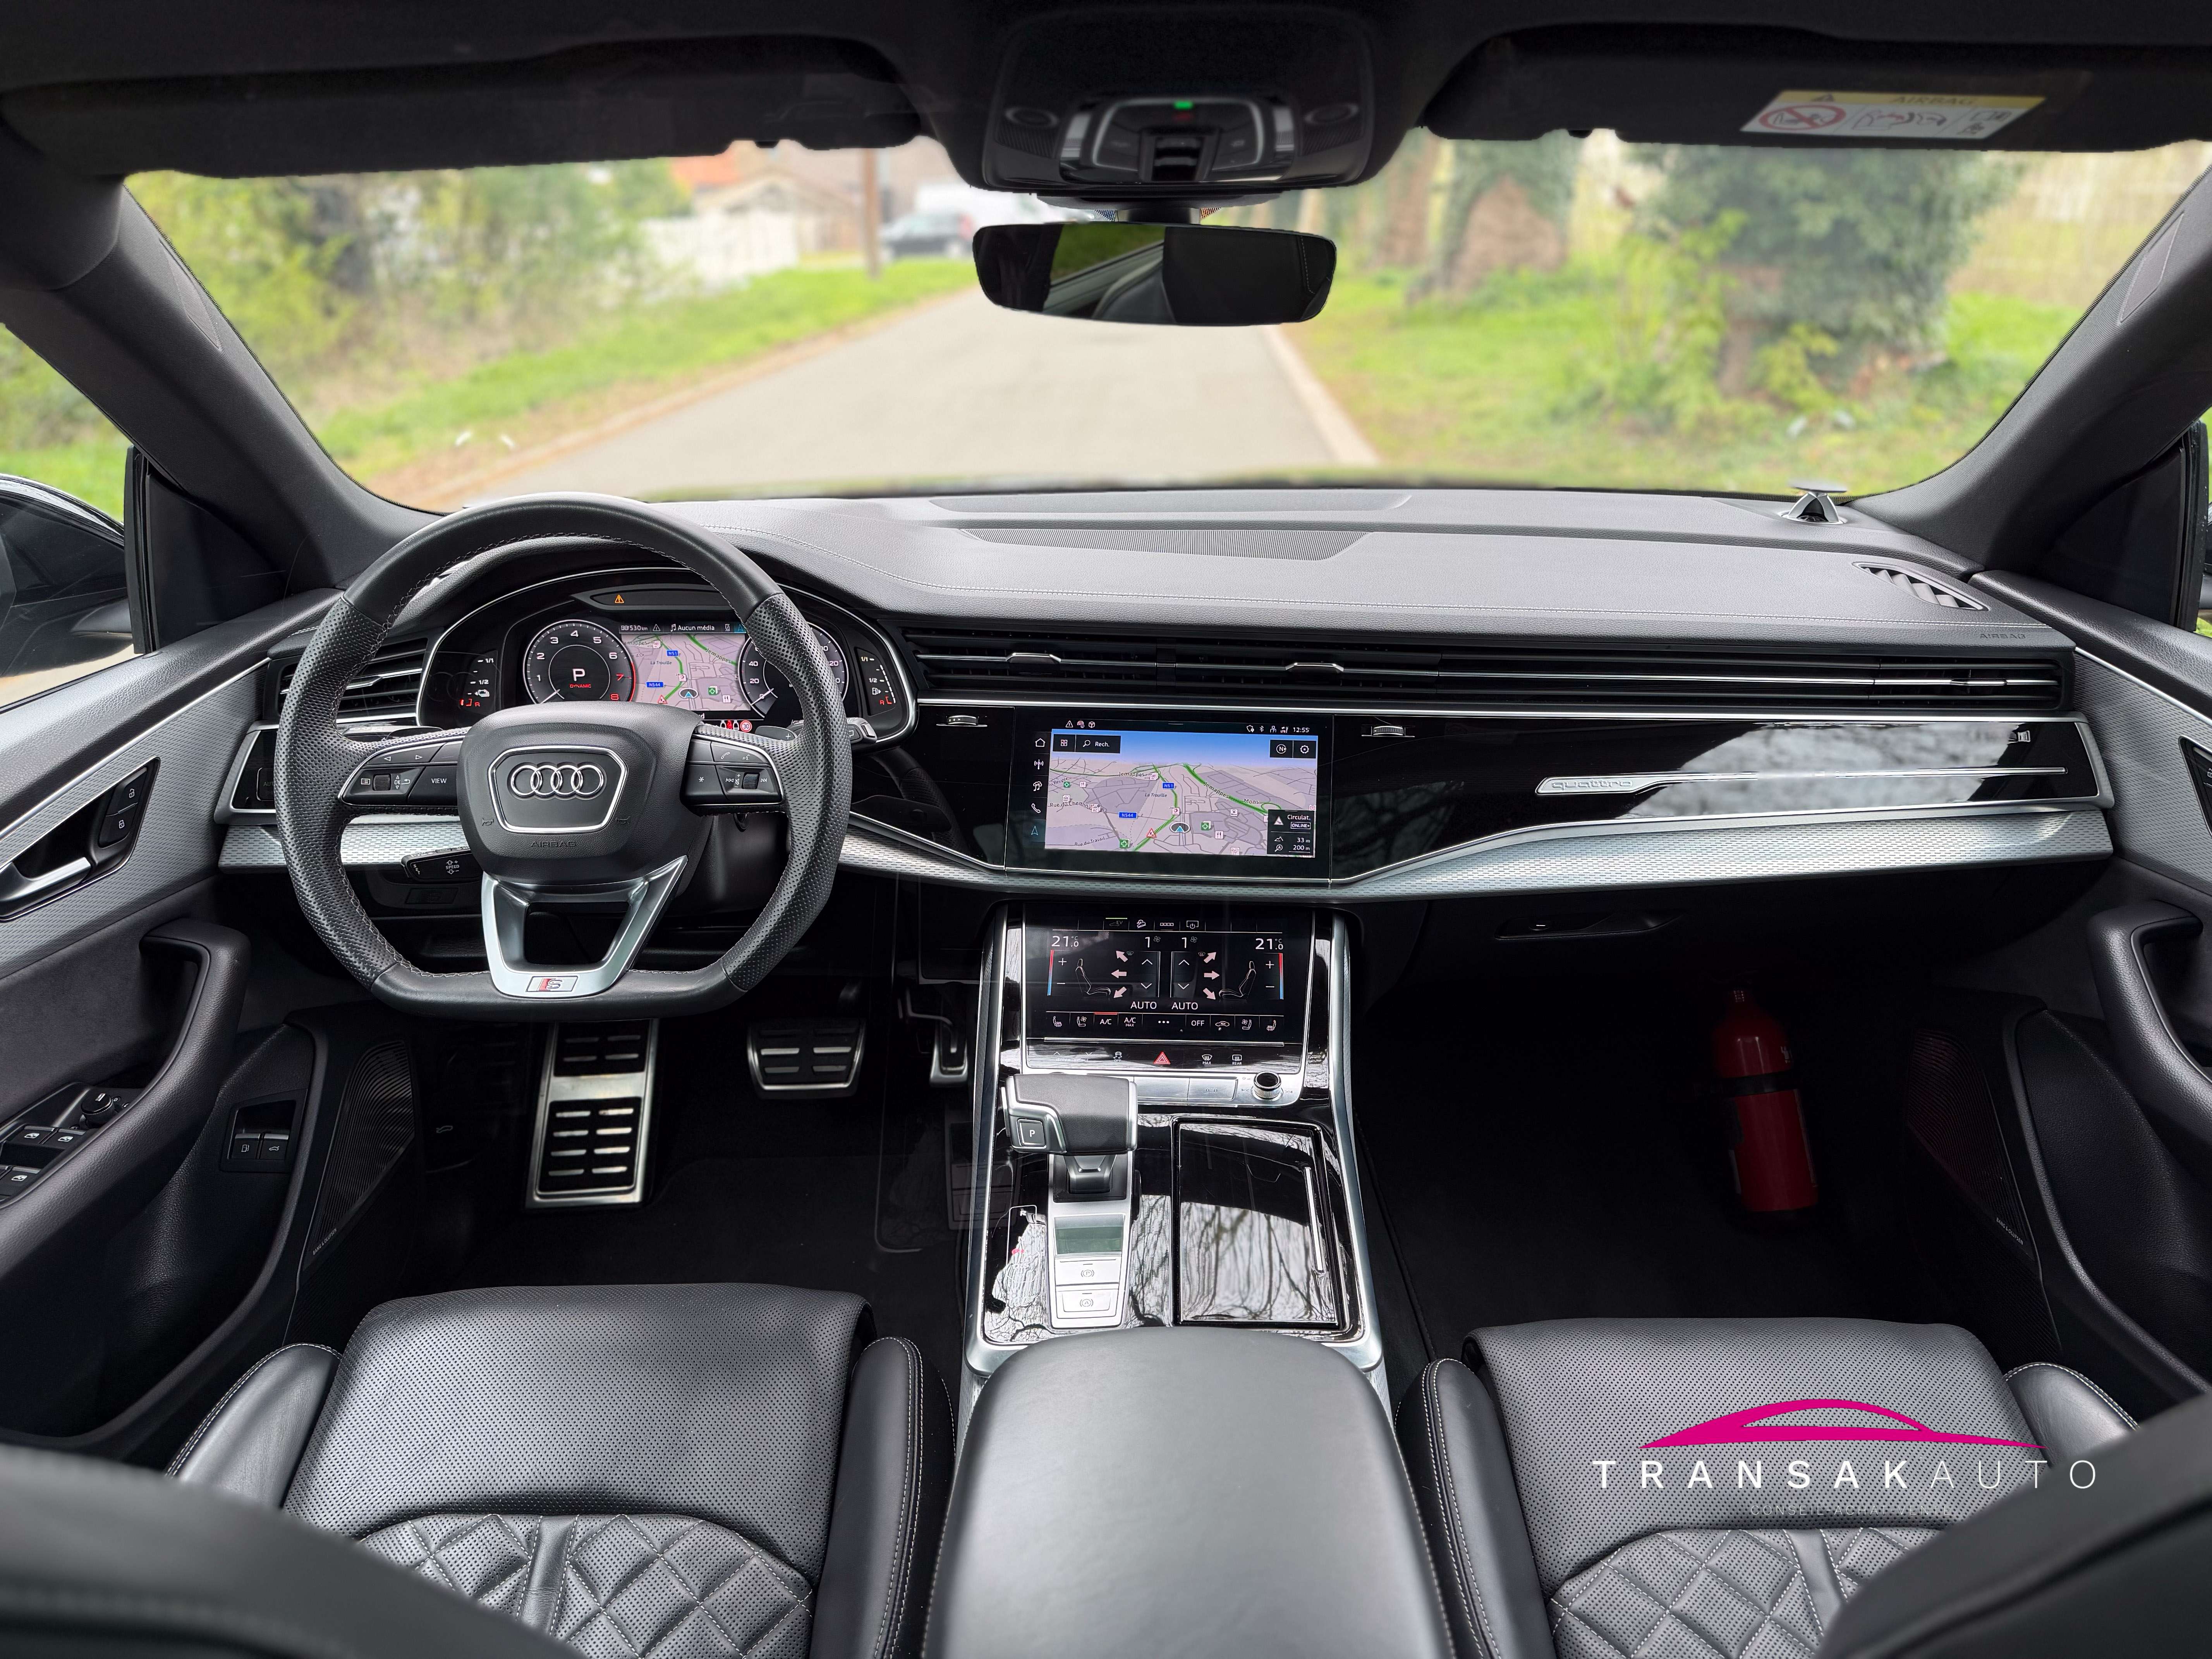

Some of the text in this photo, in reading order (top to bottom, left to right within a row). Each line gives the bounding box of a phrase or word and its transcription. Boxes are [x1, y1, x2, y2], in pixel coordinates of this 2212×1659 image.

[706, 648, 732, 664] Jemappes
[572, 668, 585, 681] P
[1204, 782, 1230, 799] Jemappes
[1552, 780, 1633, 790] quattro
[1145, 936, 1150, 948] 1
[1182, 937, 1187, 948] 1
[1171, 1002, 1199, 1010] AUTO
